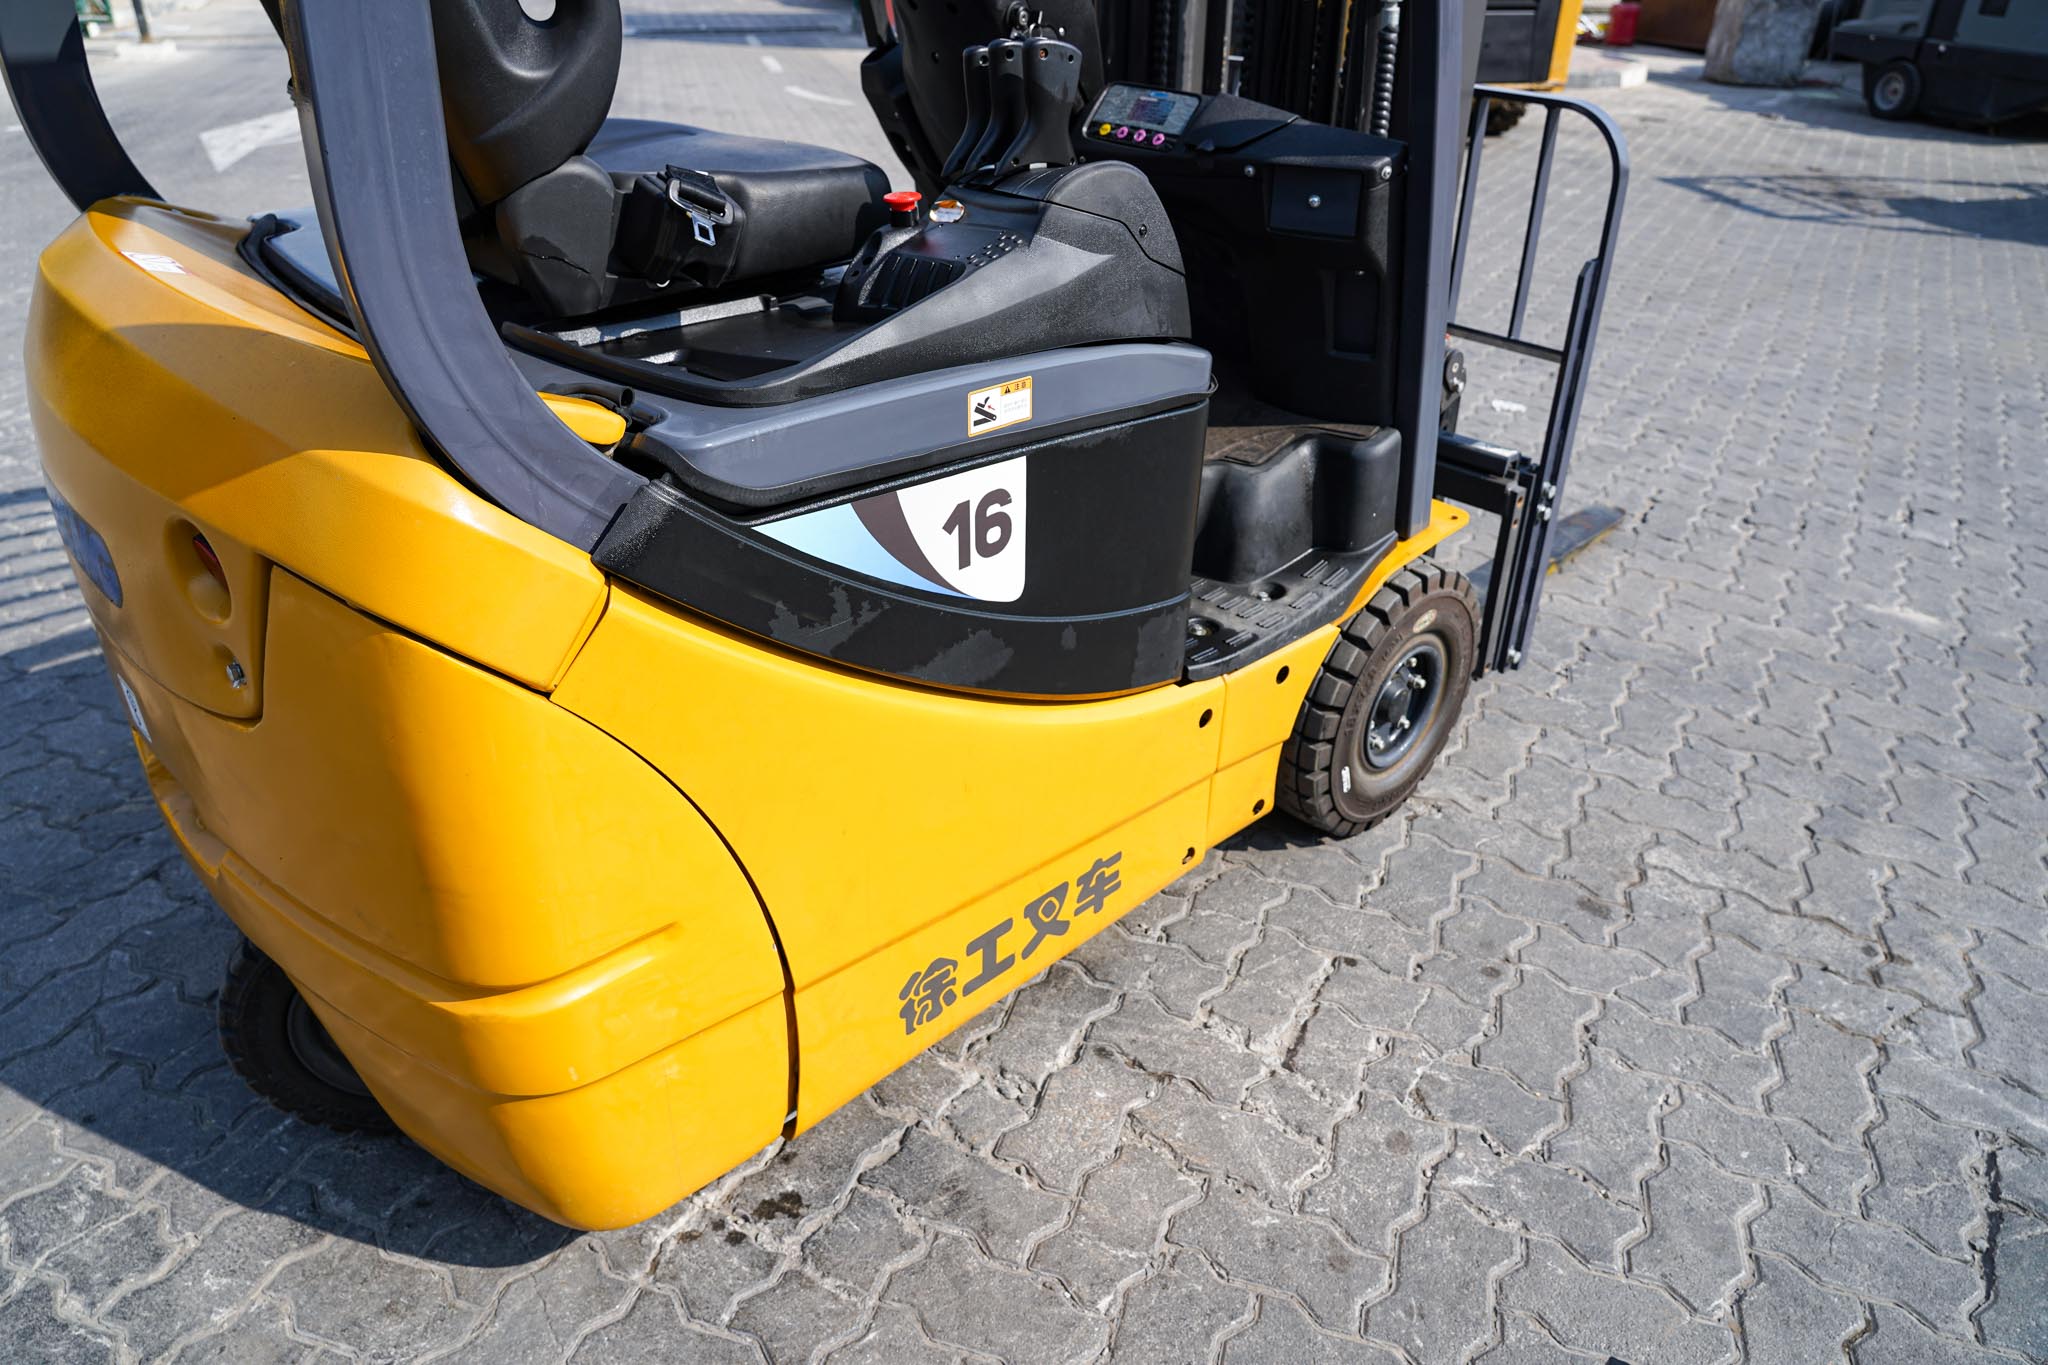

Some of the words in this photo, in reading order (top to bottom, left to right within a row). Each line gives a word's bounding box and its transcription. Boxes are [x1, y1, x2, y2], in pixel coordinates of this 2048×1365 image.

[943, 489, 1012, 570] 16
[899, 852, 1122, 1035] 徐工叉车
